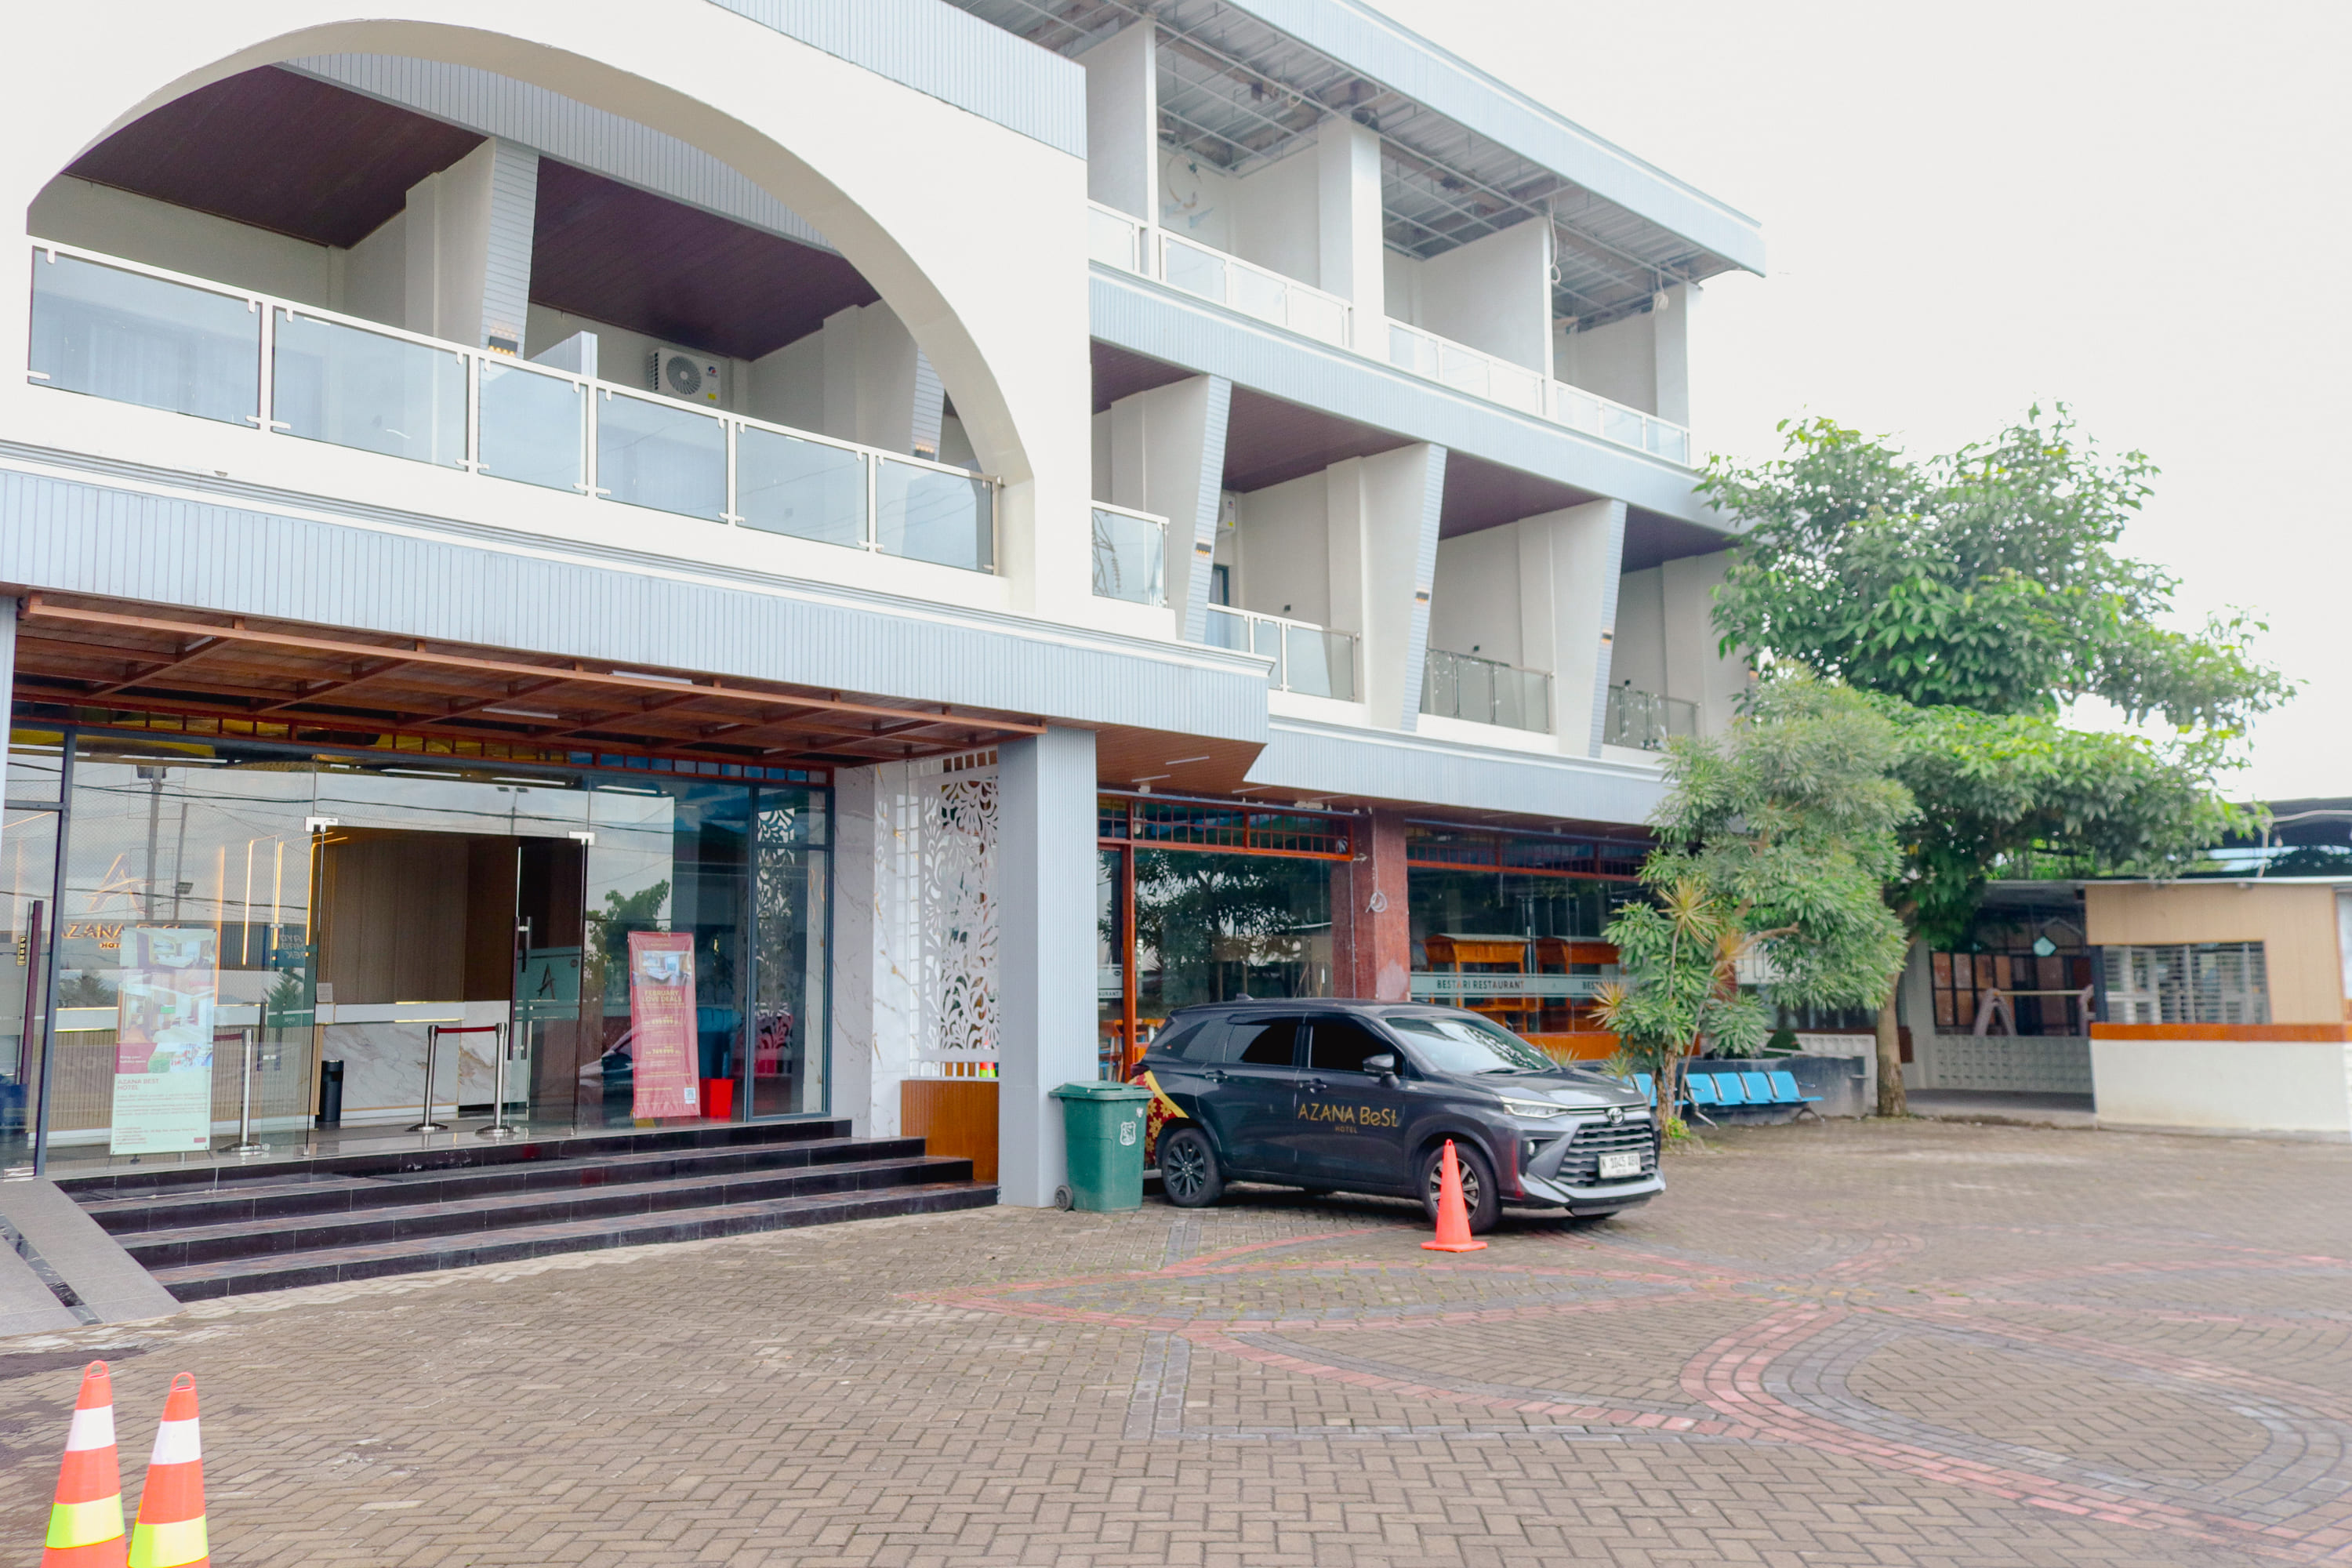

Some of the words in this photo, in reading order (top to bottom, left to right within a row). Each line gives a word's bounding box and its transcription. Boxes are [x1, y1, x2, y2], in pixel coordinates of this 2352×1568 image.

[1437, 979, 1471, 989] BESTARI
[1472, 980, 1524, 989] RESTAURANT
[1298, 1103, 1356, 1123] AZANA
[1335, 1125, 1358, 1134] HOTEL
